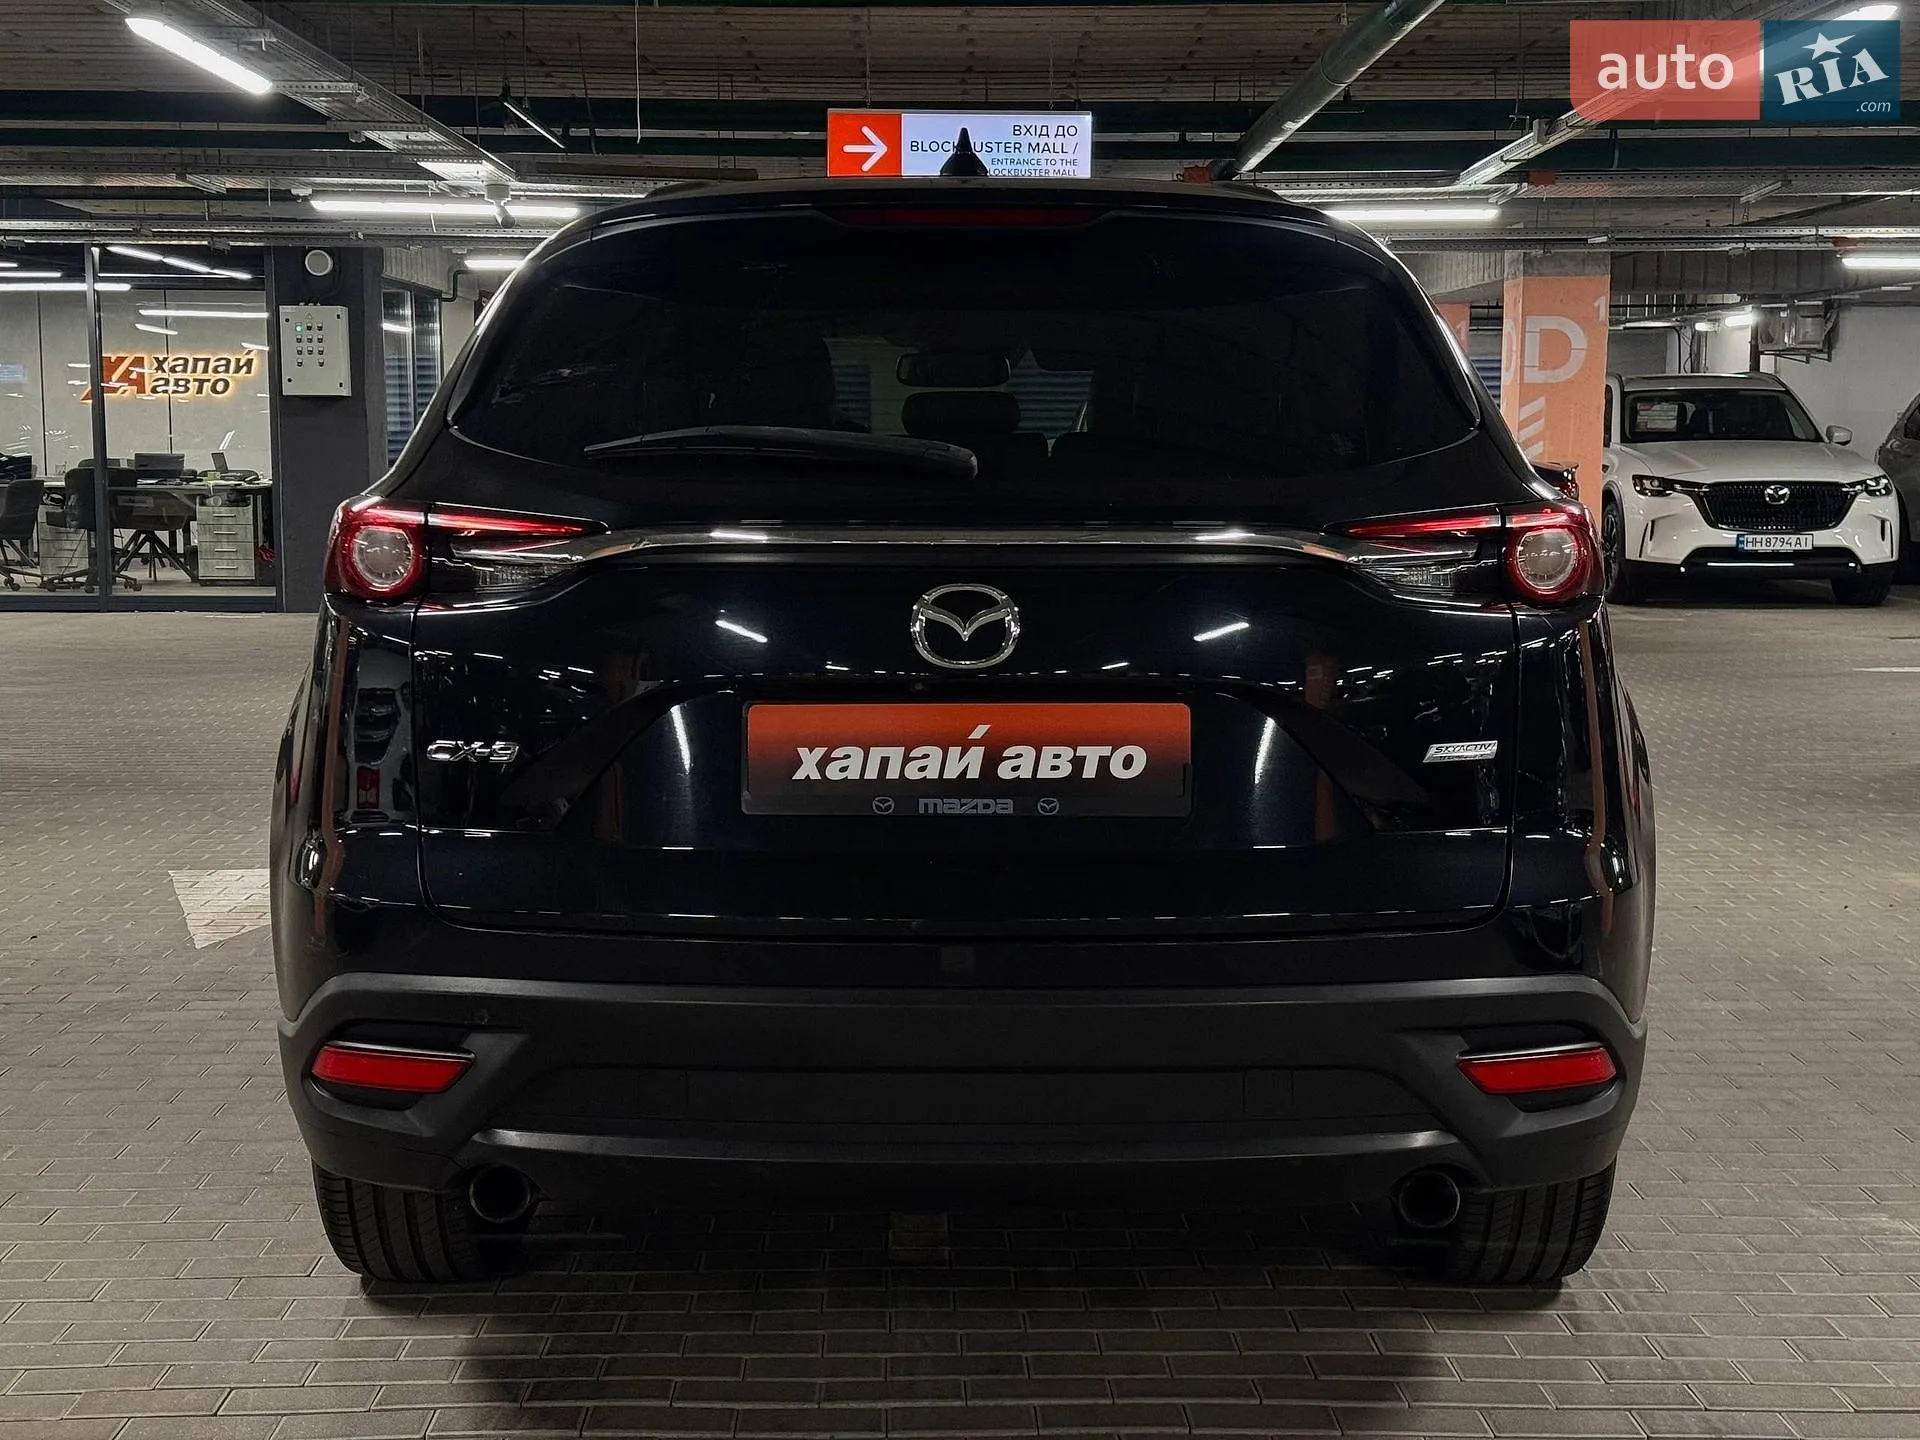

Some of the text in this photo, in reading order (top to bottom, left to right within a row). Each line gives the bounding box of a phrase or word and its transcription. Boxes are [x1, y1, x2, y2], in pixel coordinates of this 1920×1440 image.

[1012, 124, 1078, 138] ВХІД ДО
[910, 140, 1023, 154] BLOCKUSTER
[1028, 141, 1069, 154] MALL
[991, 157, 1078, 167] ENTRANCE TO THE
[988, 168, 1077, 177] LOCKBUSTER MALL
[152, 349, 255, 375] хапай
[150, 377, 231, 395] авто
[1745, 536, 1763, 548] HH
[1765, 536, 1792, 548] 8794
[426, 740, 520, 762] CX-9
[791, 724, 1147, 780] хапай авто
[1433, 743, 1492, 754] SKYACTIV
